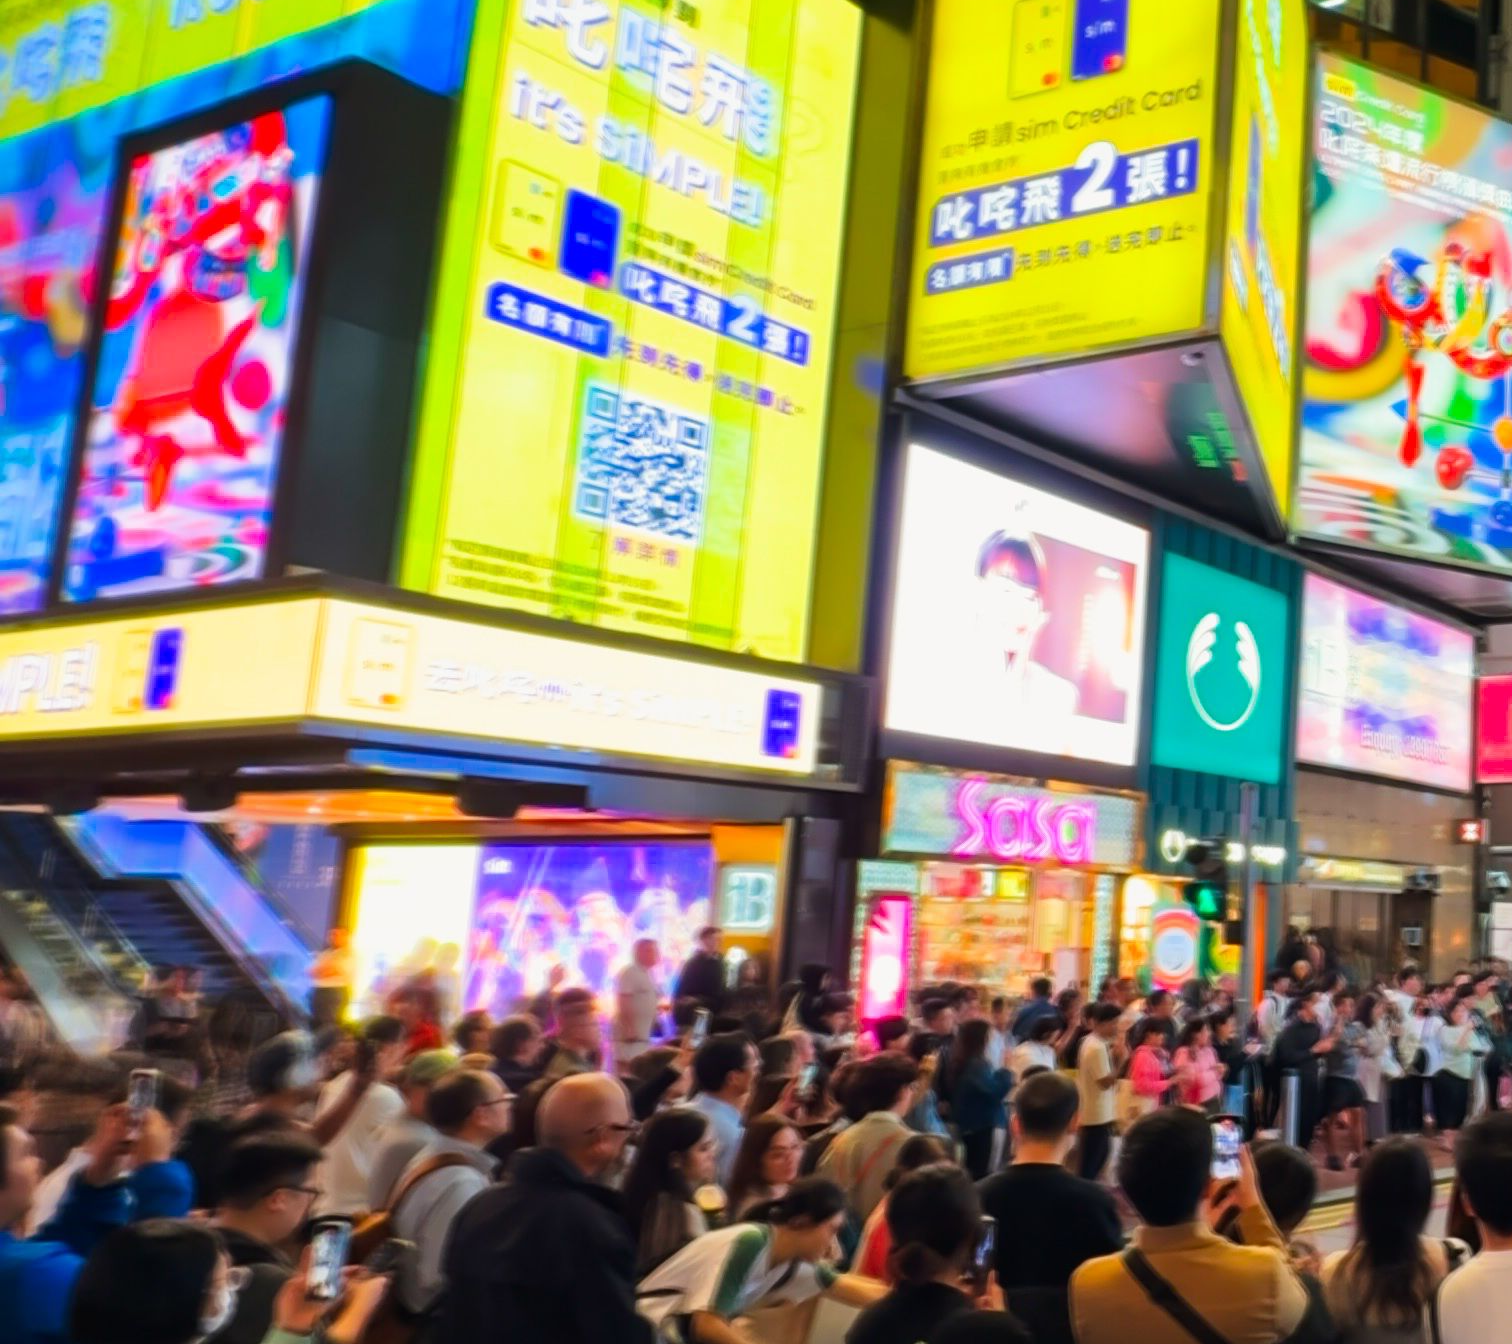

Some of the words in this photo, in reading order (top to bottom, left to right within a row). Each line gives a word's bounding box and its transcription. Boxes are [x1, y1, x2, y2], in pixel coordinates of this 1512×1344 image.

[0, 0, 112, 116] 咤飛
[1062, 96, 1136, 131] Credit
[1141, 79, 1203, 113] Card
